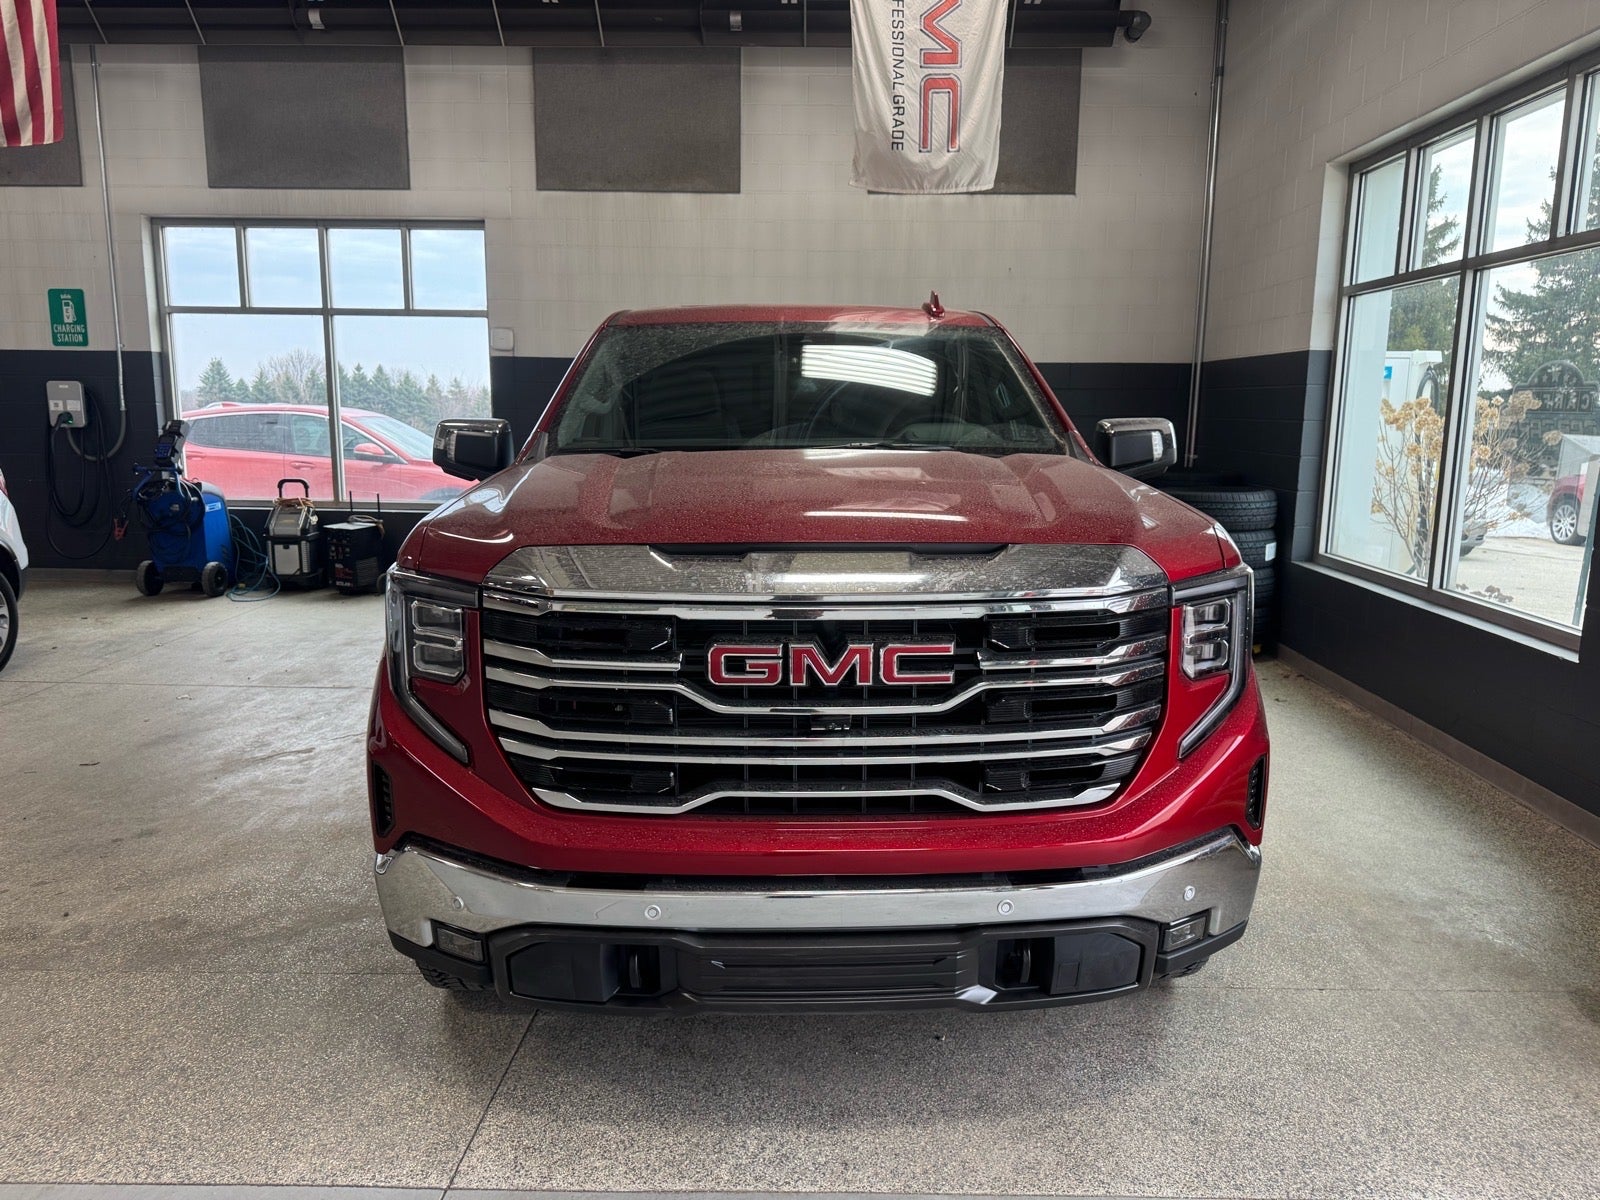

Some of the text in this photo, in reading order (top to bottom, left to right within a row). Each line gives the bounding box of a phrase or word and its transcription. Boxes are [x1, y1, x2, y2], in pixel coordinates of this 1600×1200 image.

[891, 94, 905, 151] GRADE
[53, 323, 85, 333] CHARGING
[57, 333, 83, 343] STATION
[708, 643, 954, 686] GMC
